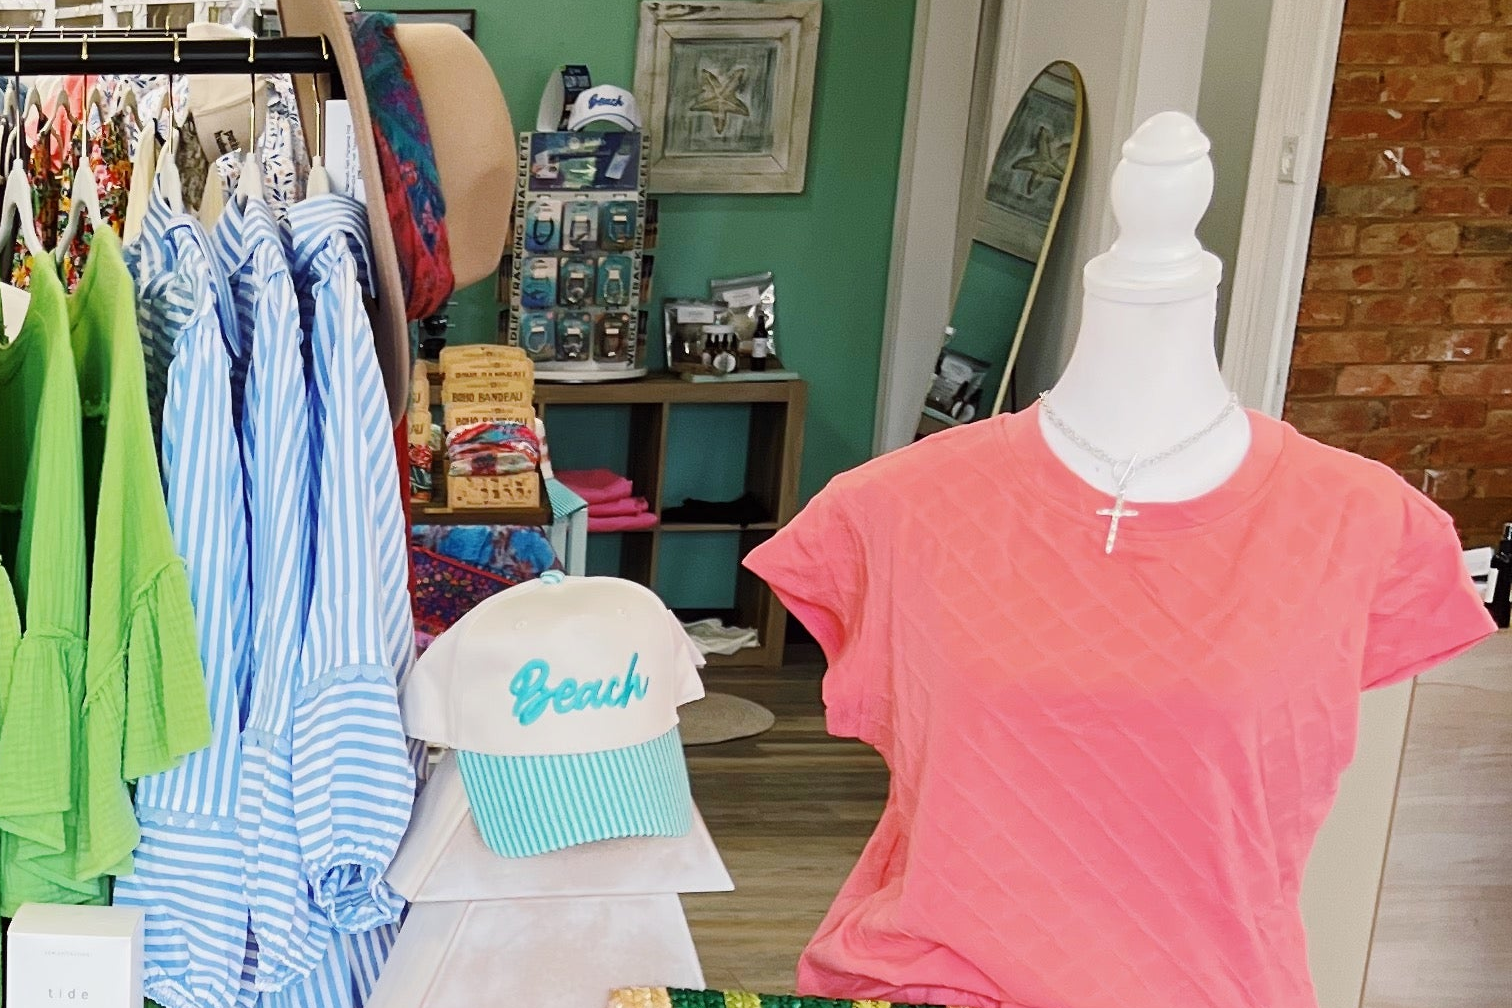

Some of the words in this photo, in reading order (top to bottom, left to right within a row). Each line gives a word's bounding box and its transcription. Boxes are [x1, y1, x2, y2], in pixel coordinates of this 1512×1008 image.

[515, 136, 529, 216] BRACELETS
[478, 392, 523, 402] BANDEAU
[509, 652, 650, 726] Beach
[48, 988, 89, 1000] tide
